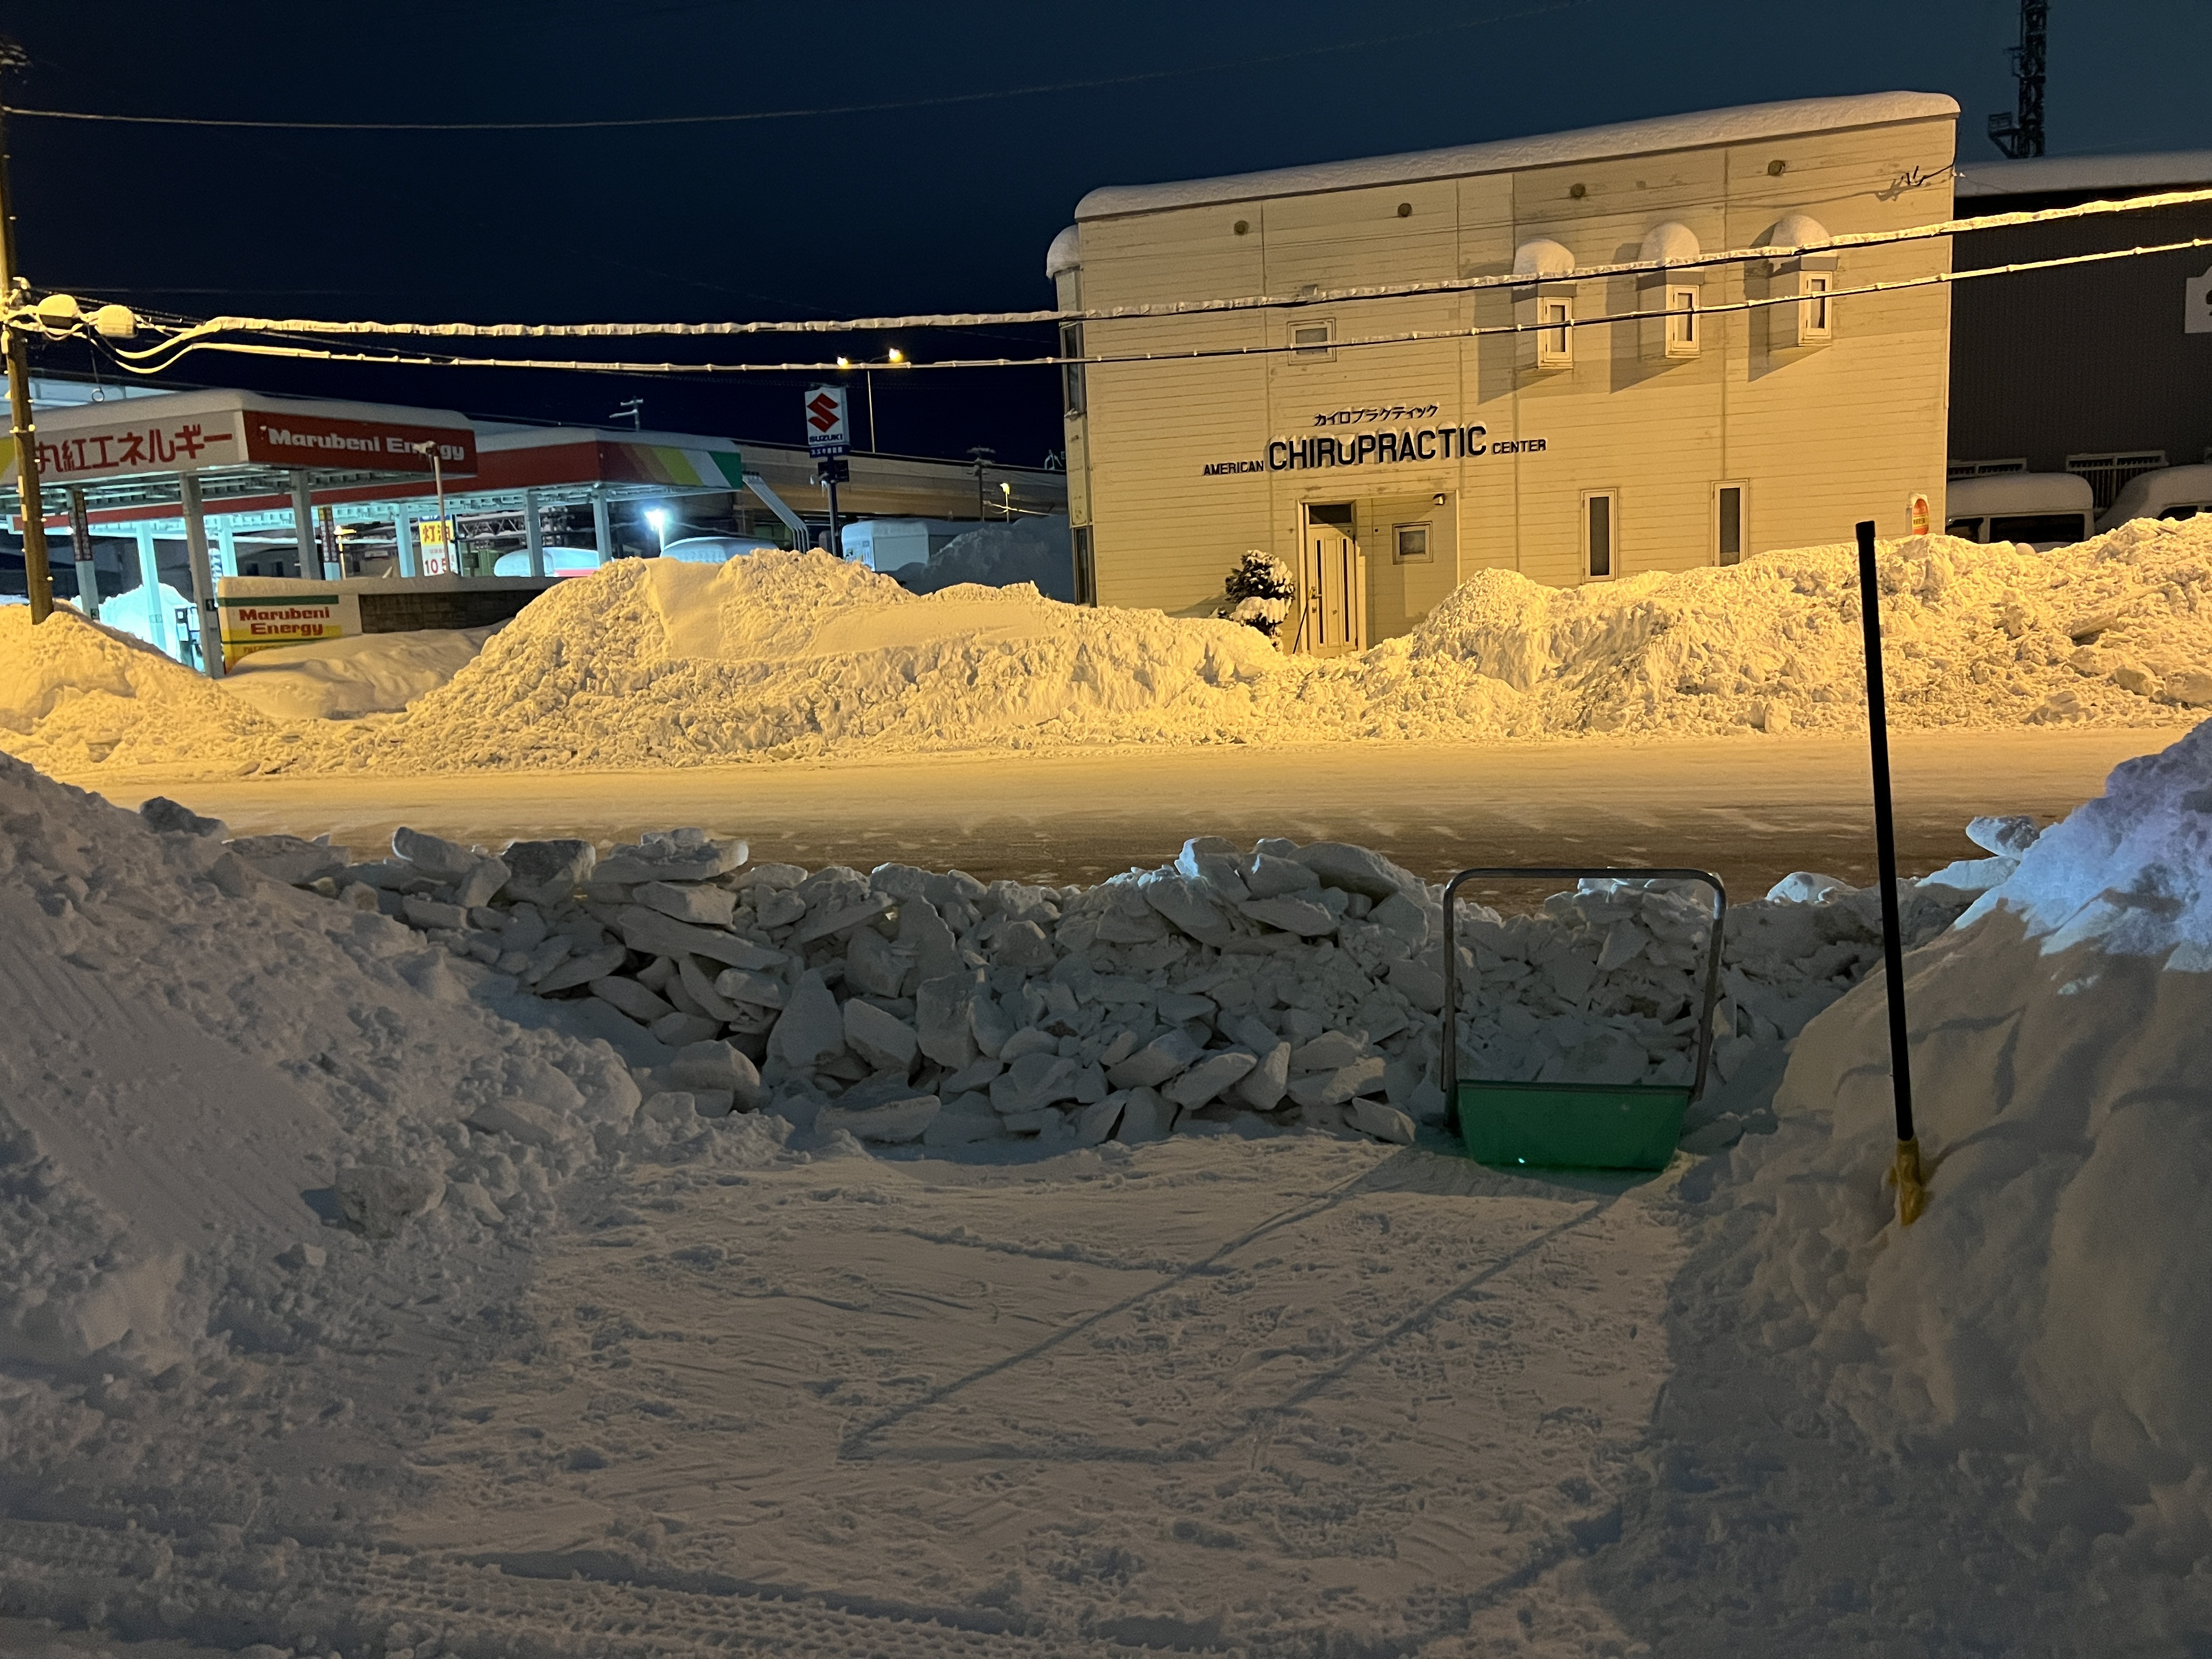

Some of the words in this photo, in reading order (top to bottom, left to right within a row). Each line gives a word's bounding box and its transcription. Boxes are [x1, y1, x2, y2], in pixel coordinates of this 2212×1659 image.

[36, 424, 233, 475] 丸紅エネルギー
[268, 428, 380, 452] Marubeni
[386, 437, 465, 461] Engy
[809, 433, 843, 443] SUZUKI
[1204, 460, 1264, 476] AMERICAN
[1269, 426, 1487, 470] CHIROPRACTIC
[1493, 439, 1546, 454] CENTER
[238, 606, 331, 622] Marubeni
[250, 622, 324, 636] Energy
